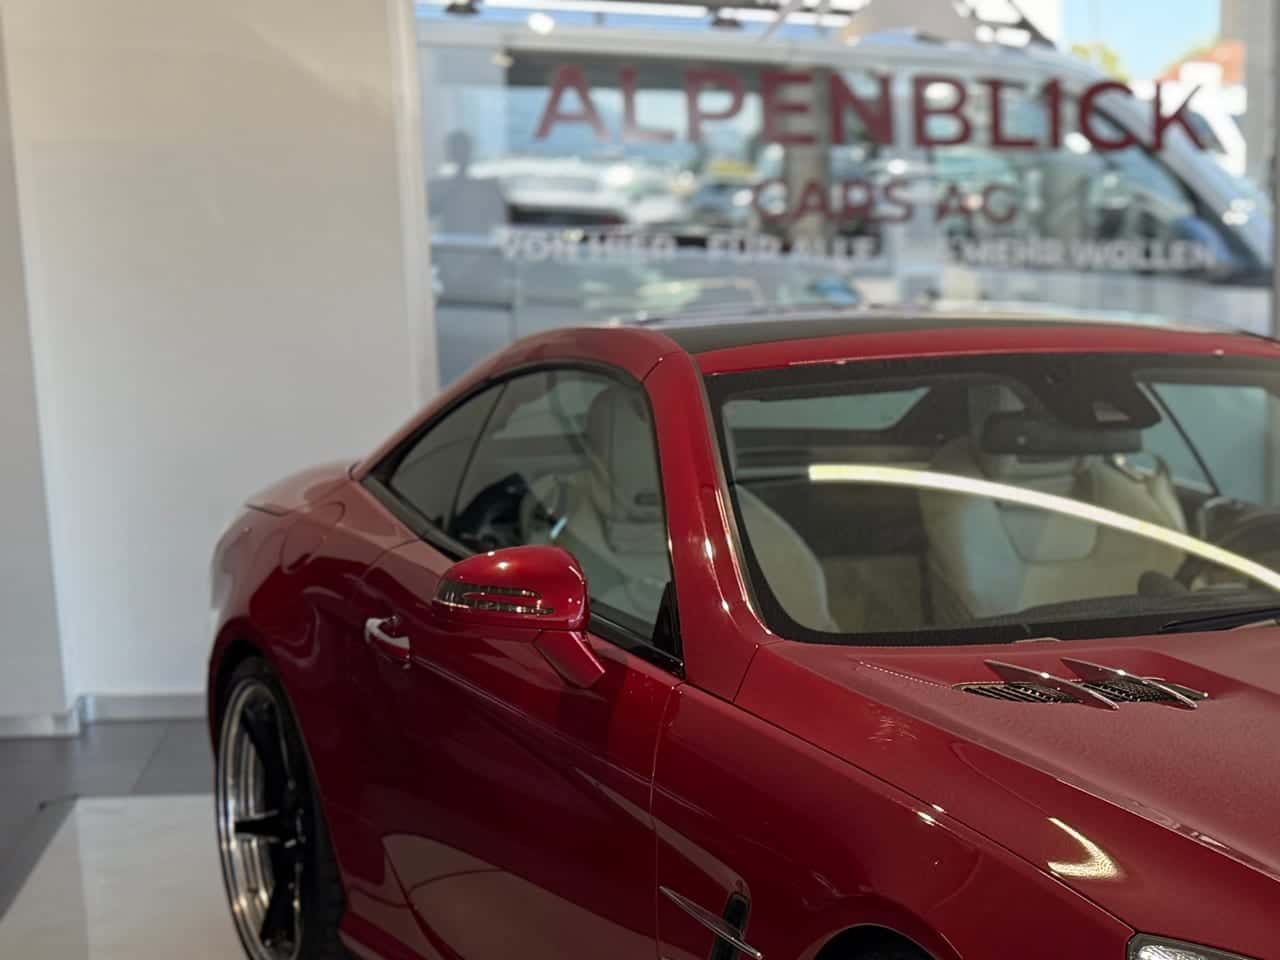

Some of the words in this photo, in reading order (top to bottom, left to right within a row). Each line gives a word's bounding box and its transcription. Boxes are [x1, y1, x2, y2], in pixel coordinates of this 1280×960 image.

[534, 64, 1210, 153] ALPENBLICK
[753, 179, 914, 224] CARS
[934, 183, 1019, 225] AG
